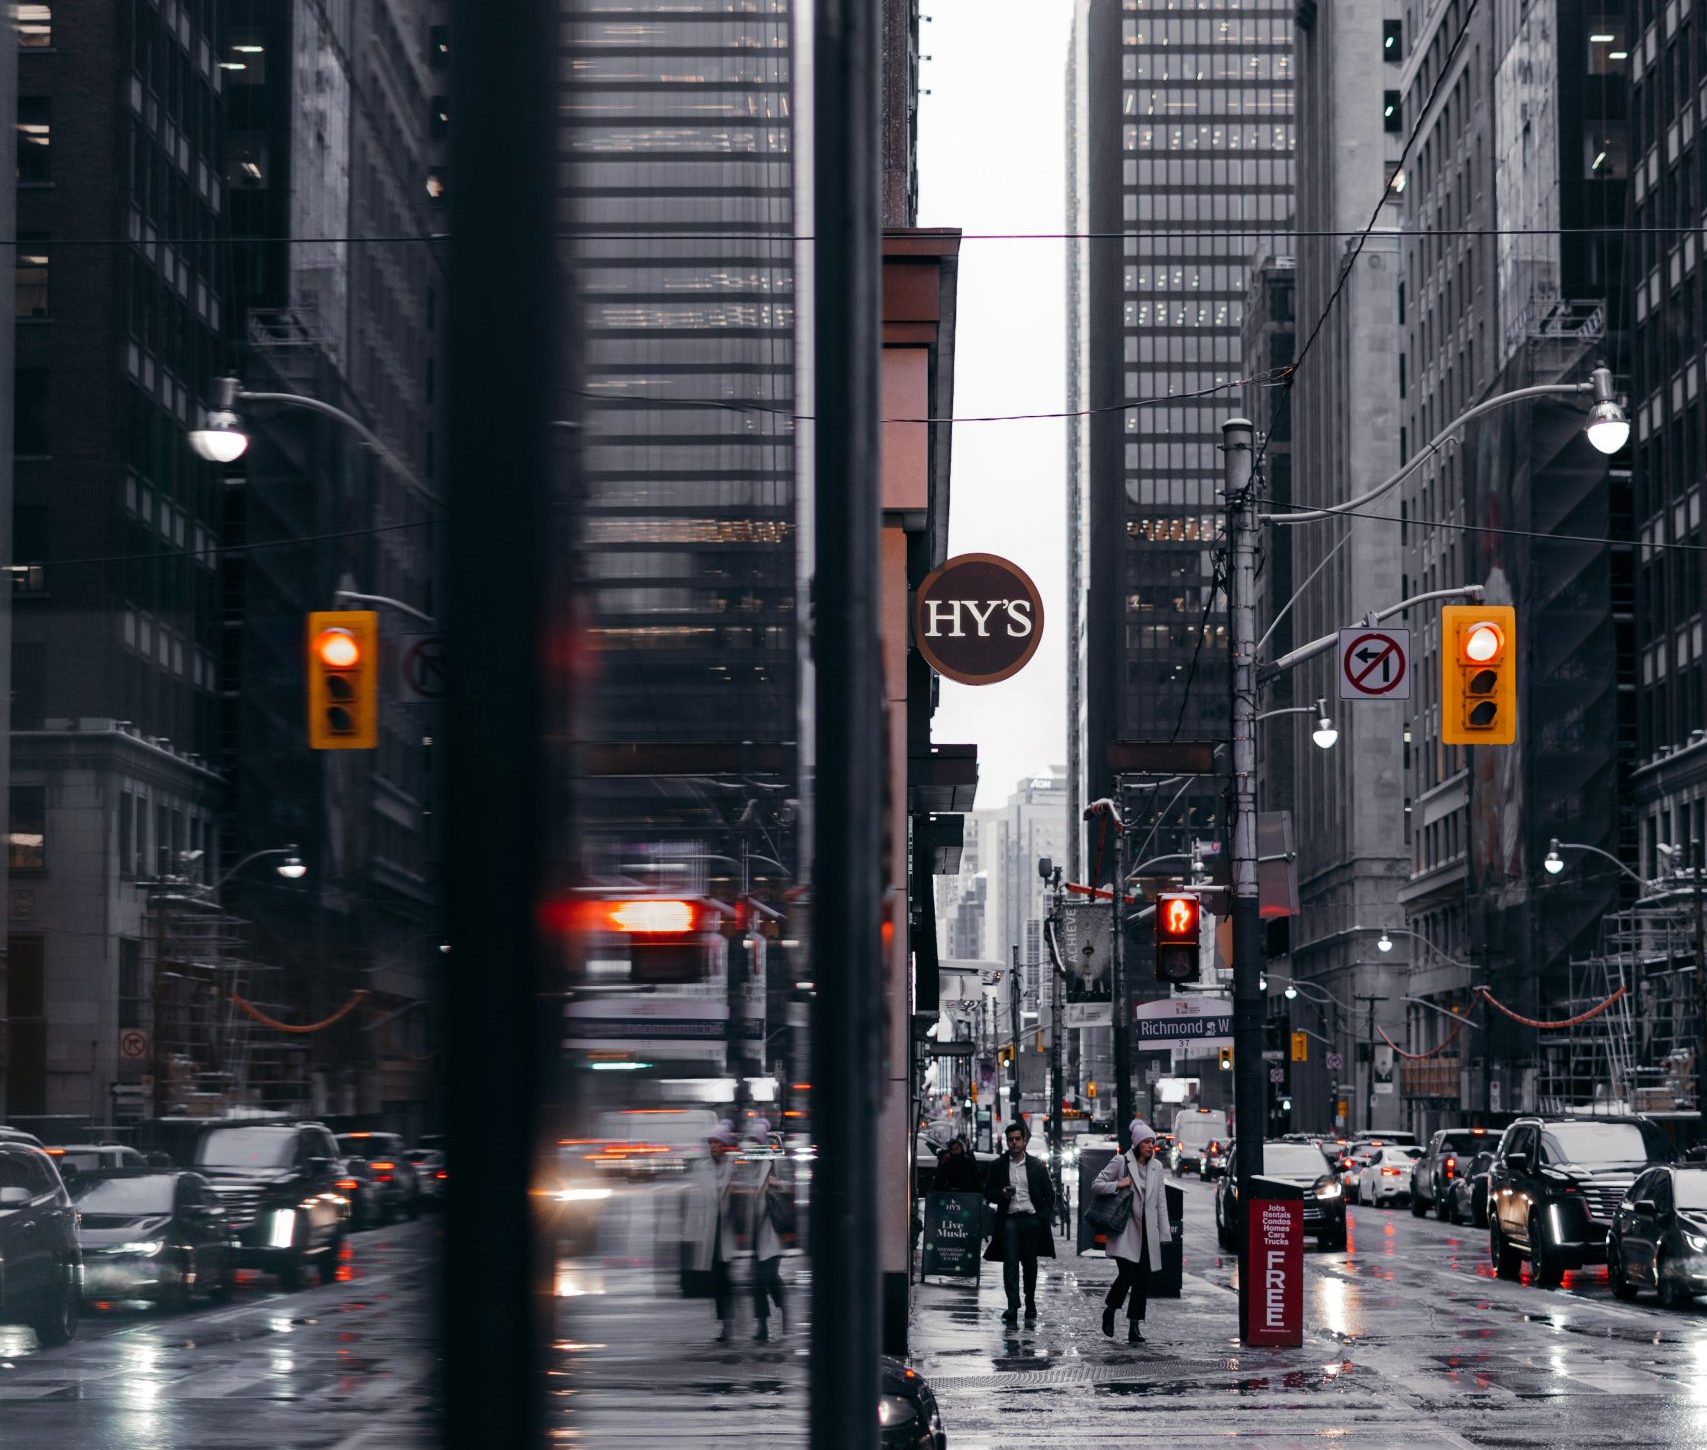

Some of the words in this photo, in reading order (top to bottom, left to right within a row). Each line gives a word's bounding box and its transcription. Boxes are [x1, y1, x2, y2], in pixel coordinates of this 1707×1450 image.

[925, 599, 1032, 637] HY'S
[1066, 908, 1078, 963] ACHIEVE
[1141, 1020, 1203, 1035] Richmond
[1218, 1018, 1230, 1032] W
[936, 1229, 968, 1238] Music
[942, 1220, 964, 1229] Live
[1265, 1250, 1286, 1327] FREE
